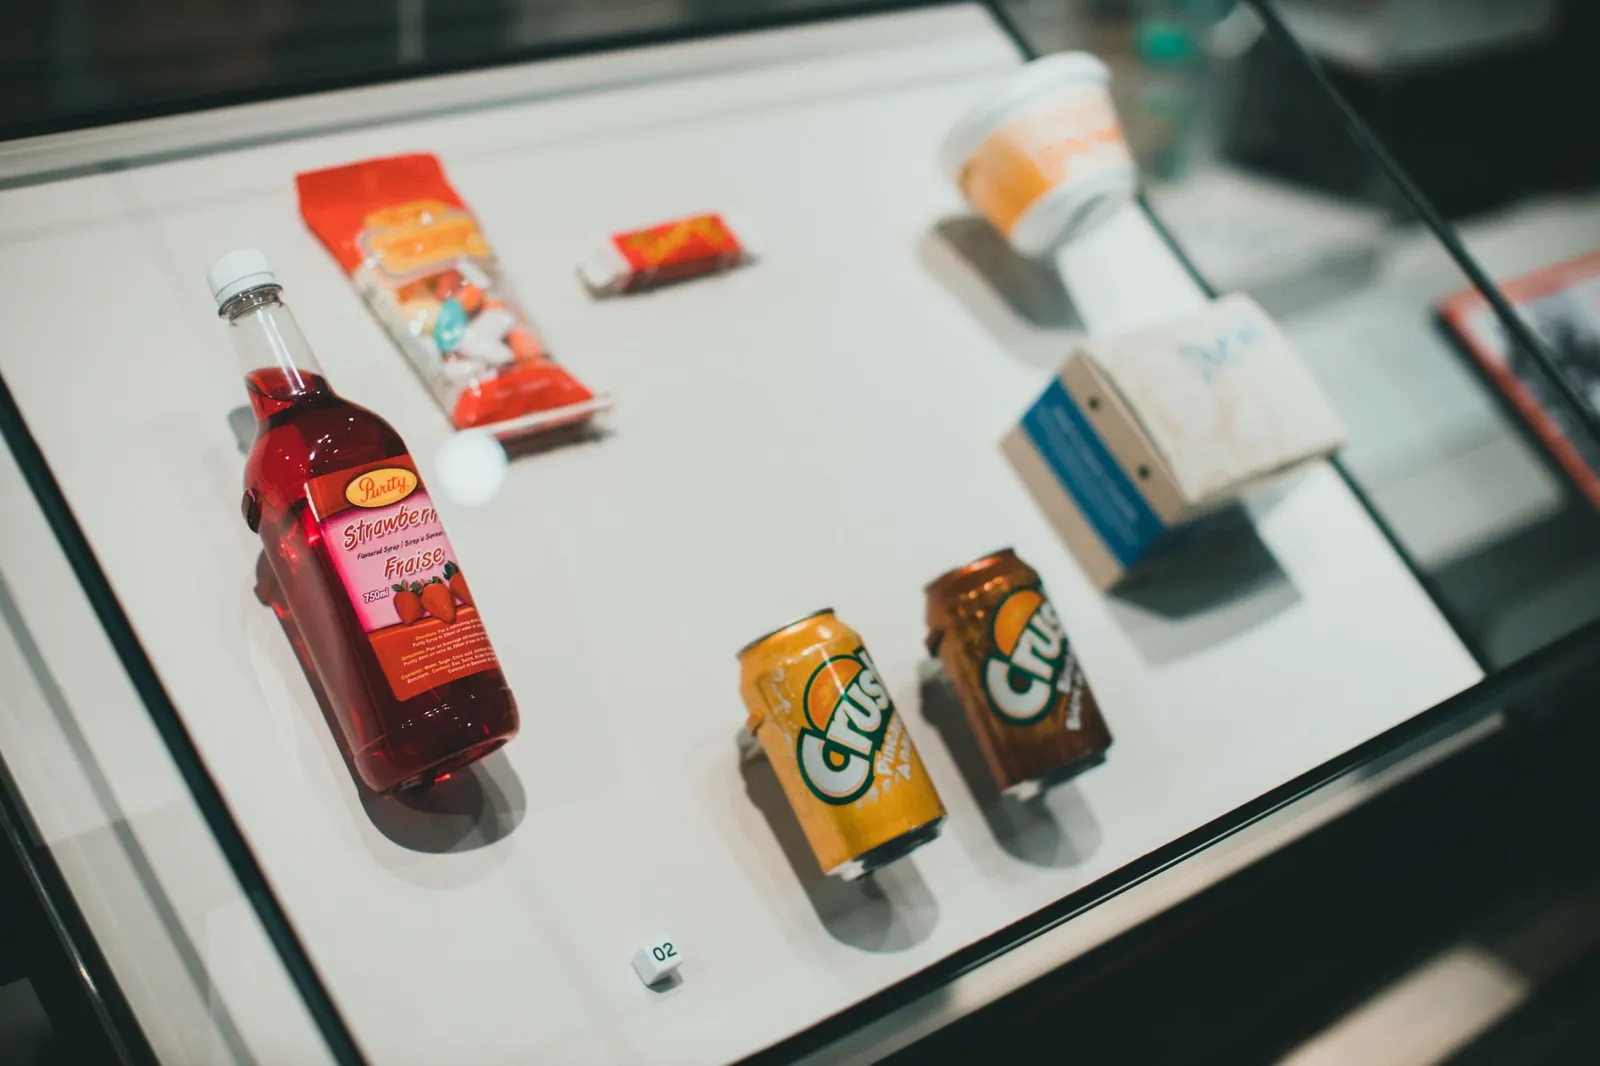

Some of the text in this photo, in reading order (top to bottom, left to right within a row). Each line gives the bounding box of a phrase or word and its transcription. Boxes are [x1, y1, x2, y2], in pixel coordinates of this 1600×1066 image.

[358, 475, 408, 503] Purity
[343, 503, 438, 550] Strawberr
[384, 547, 445, 579] Fraise
[363, 587, 390, 604] 750ml
[987, 600, 1067, 719] Crus
[653, 942, 678, 962] 02
